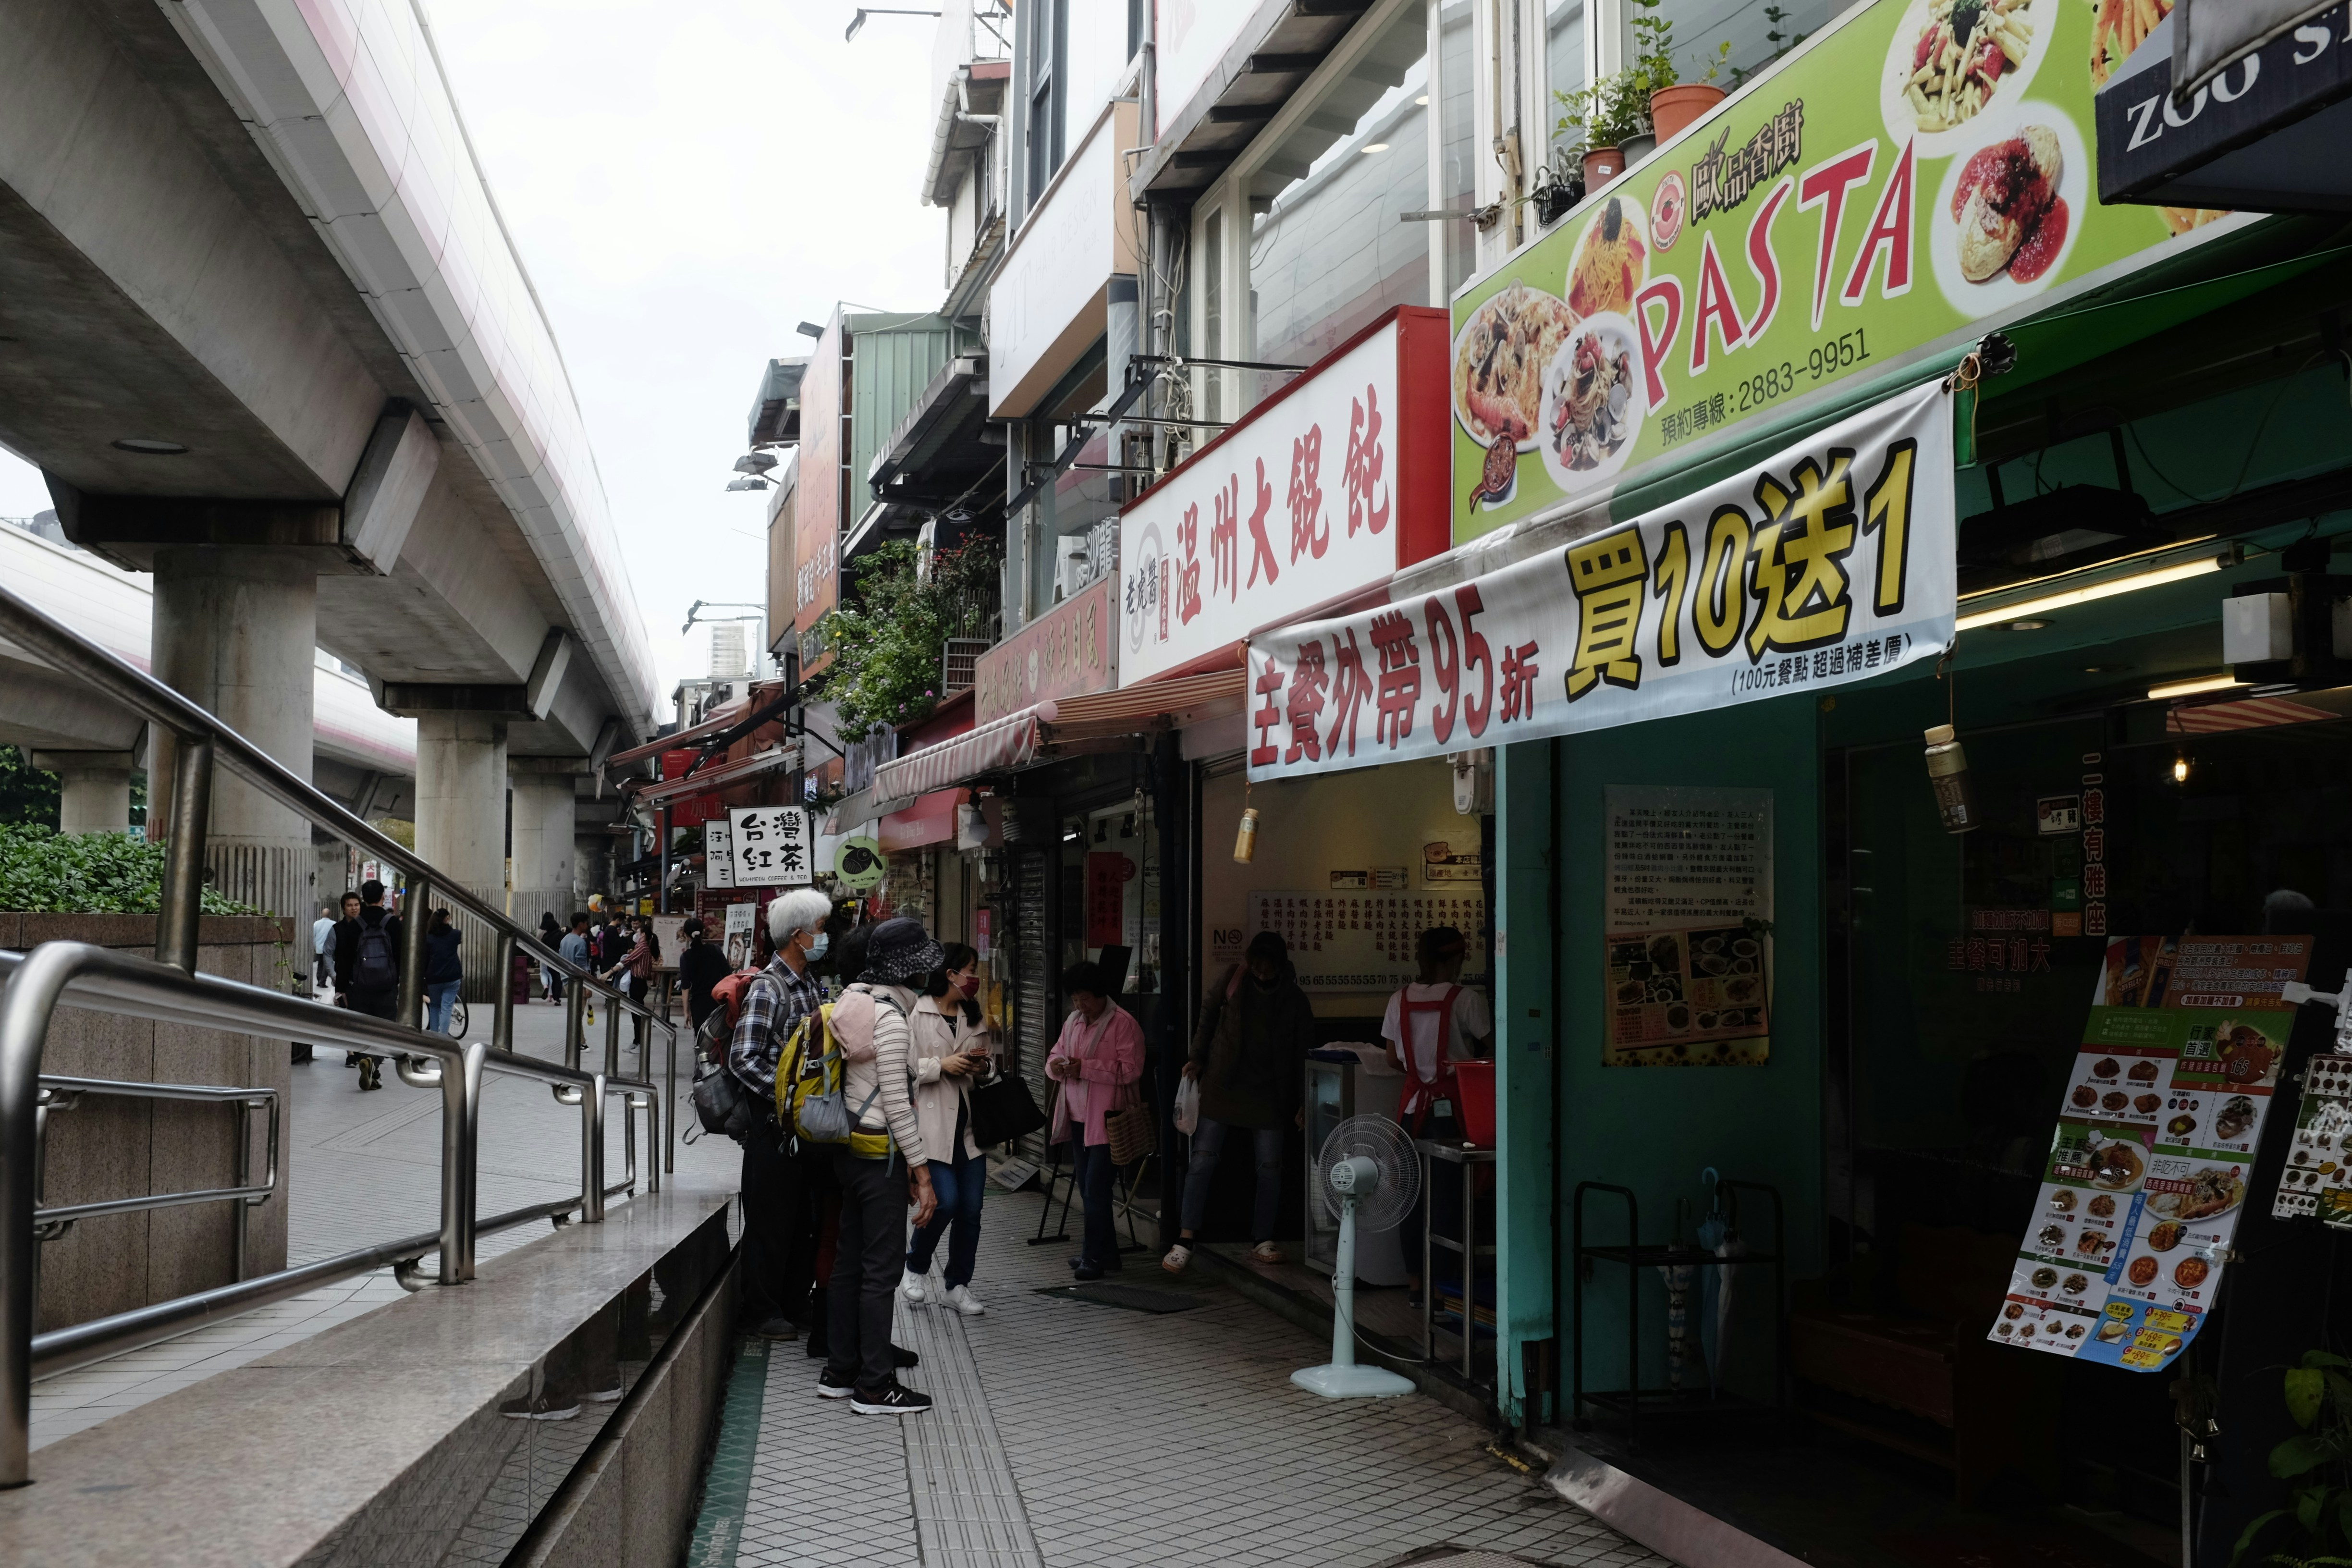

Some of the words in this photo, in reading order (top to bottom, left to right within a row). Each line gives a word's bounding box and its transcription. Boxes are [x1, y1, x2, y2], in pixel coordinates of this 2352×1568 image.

[2127, 52, 2260, 152] ZOO
[1635, 135, 1918, 416] PASTA
[1565, 437, 1918, 703] 買10送1
[1732, 654, 1808, 696] (100元餐點
[1813, 632, 1912, 679] 超過補差價)
[1251, 582, 1539, 768] 主餐外帶95折
[740, 811, 802, 841] 台灣
[2082, 752, 2107, 937] 二樓有雅座
[742, 843, 804, 872] 紅茶
[1429, 869, 1452, 877] 原產地
[1972, 909, 2050, 931] 加麵加飯不加價
[1948, 937, 2051, 973] 主餐可加大
[1299, 976, 1311, 986] 95
[1313, 976, 1324, 985] 65
[1325, 976, 1337, 985] 55
[1338, 976, 1349, 985] 55
[1350, 976, 1362, 985] 55
[1363, 975, 1376, 985] 55
[1377, 975, 1386, 984] 70
[1389, 975, 1398, 984] 75
[1402, 975, 1411, 984] 80
[2121, 978, 2142, 992] DIVELLA
[2190, 1026, 2216, 1041] 行家
[2184, 1041, 2211, 1057] 首選
[2180, 1061, 2228, 1073] 炸豬排蛋包飯
[2230, 1057, 2250, 1076] 165
[2060, 1137, 2086, 1151] 主廚
[2057, 1150, 2083, 1164] 推薦
[2151, 1159, 2191, 1176] 非吃不可
[2146, 1308, 2153, 1316] A
